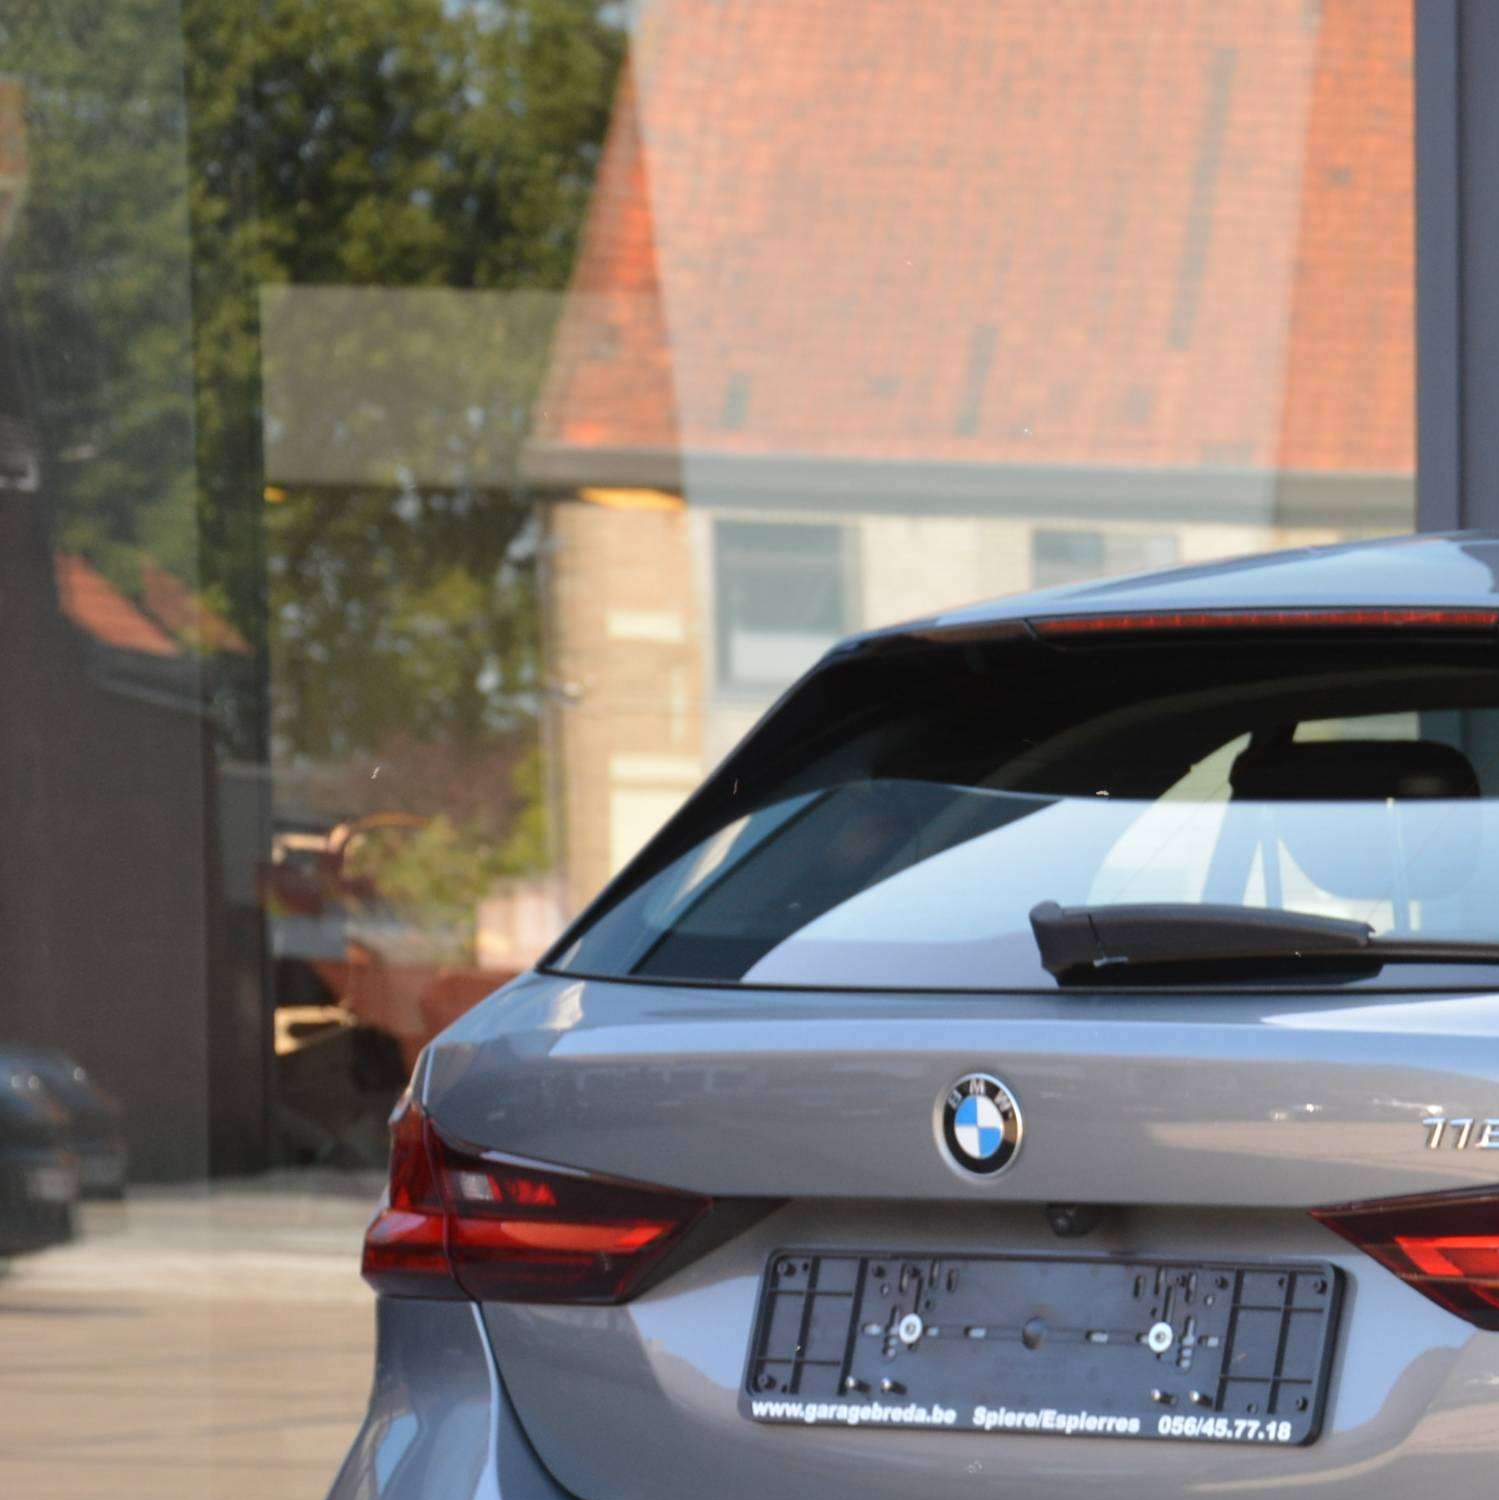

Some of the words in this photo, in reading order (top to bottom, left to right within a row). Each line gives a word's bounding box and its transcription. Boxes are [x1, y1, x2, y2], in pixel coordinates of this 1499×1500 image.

[751, 1400, 958, 1425] www.garagebreda.be
[972, 1405, 1142, 1435] Spiere/Espierres
[1157, 1414, 1293, 1442] 056/45.77.18
